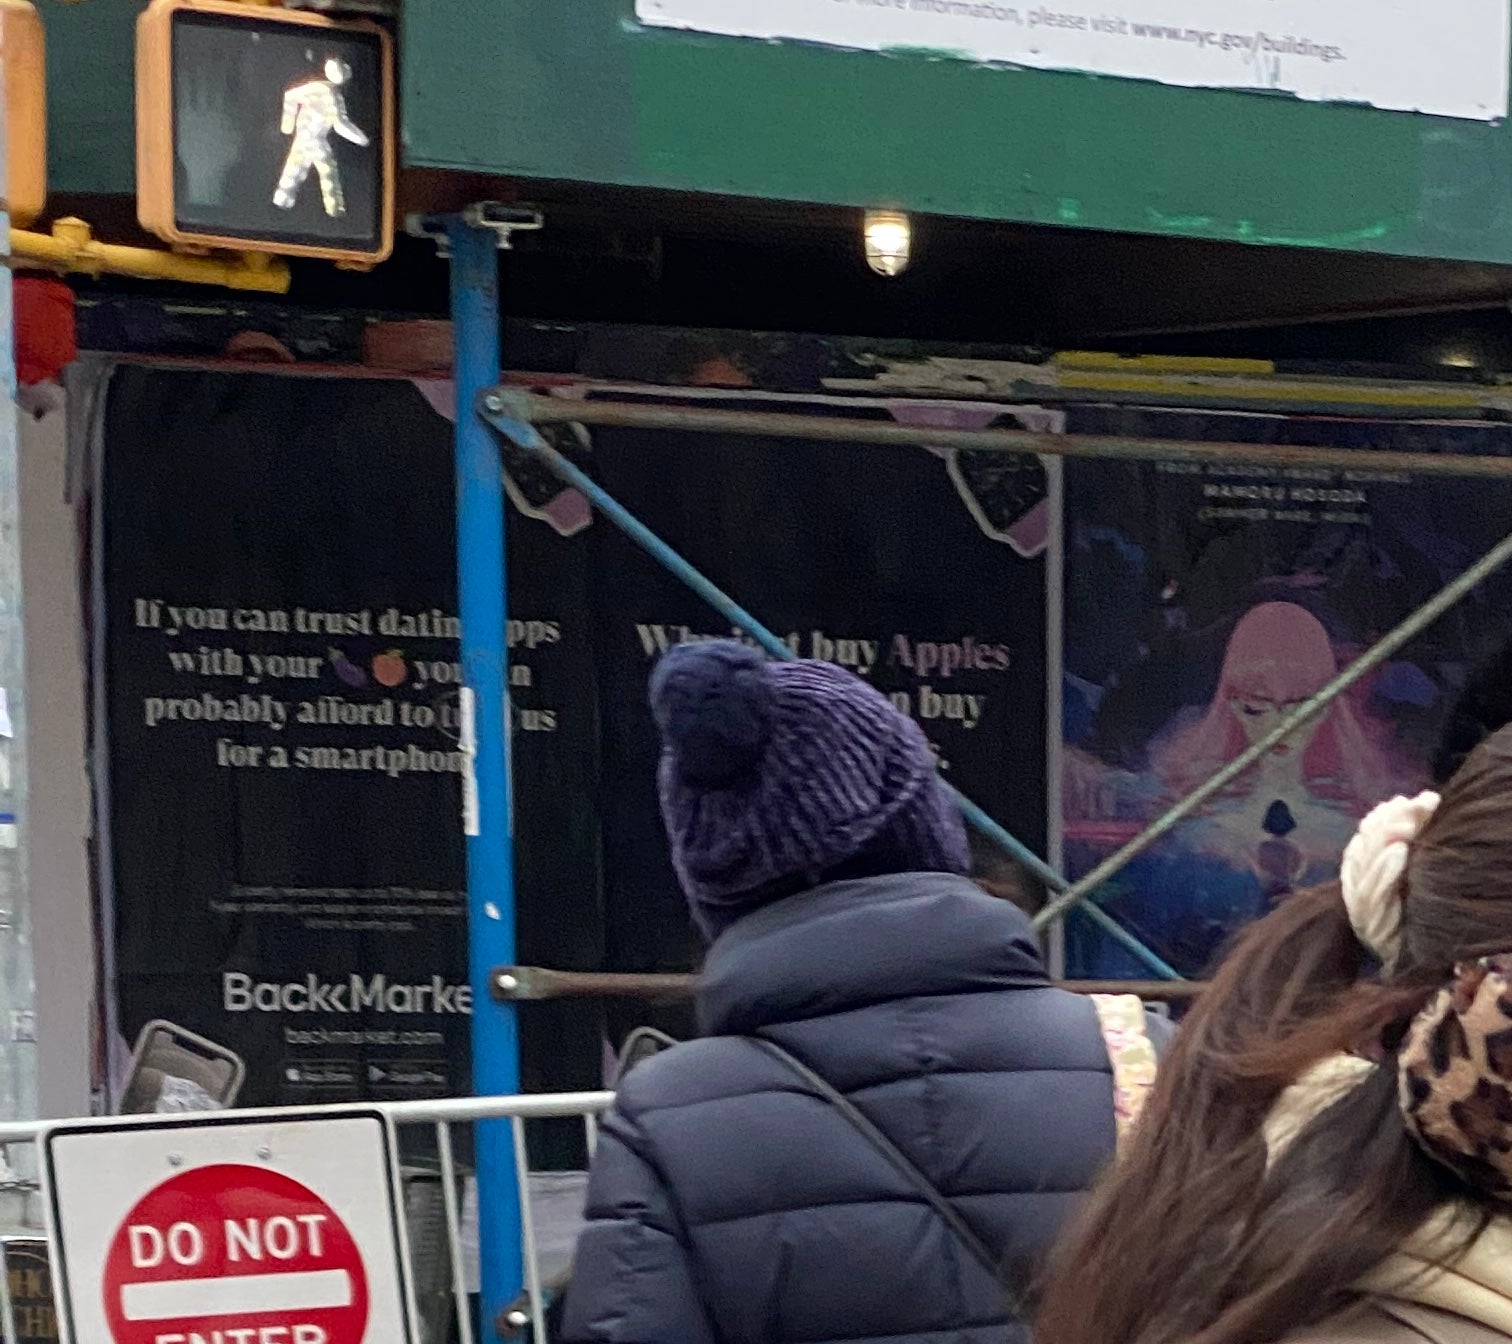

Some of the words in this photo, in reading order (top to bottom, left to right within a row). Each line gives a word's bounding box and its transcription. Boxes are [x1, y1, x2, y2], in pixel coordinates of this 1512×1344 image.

[1027, 5, 1087, 31] please
[1089, 15, 1129, 36] visit
[135, 598, 164, 628] If
[164, 606, 228, 636] you
[232, 608, 289, 632] can
[294, 607, 373, 635] trust
[378, 608, 462, 638] datin
[505, 619, 561, 648] pps
[168, 646, 243, 676] with
[247, 654, 323, 684] your
[812, 630, 879, 674] buy
[887, 634, 1010, 677] Apples
[144, 692, 287, 731] probably
[296, 695, 394, 726] afford
[400, 701, 435, 728] to
[919, 685, 987, 729] buy
[216, 737, 263, 767] for
[267, 746, 289, 768] a
[294, 744, 465, 778] smartphon
[128, 1221, 203, 1268] DO
[224, 1214, 327, 1261] NOT
